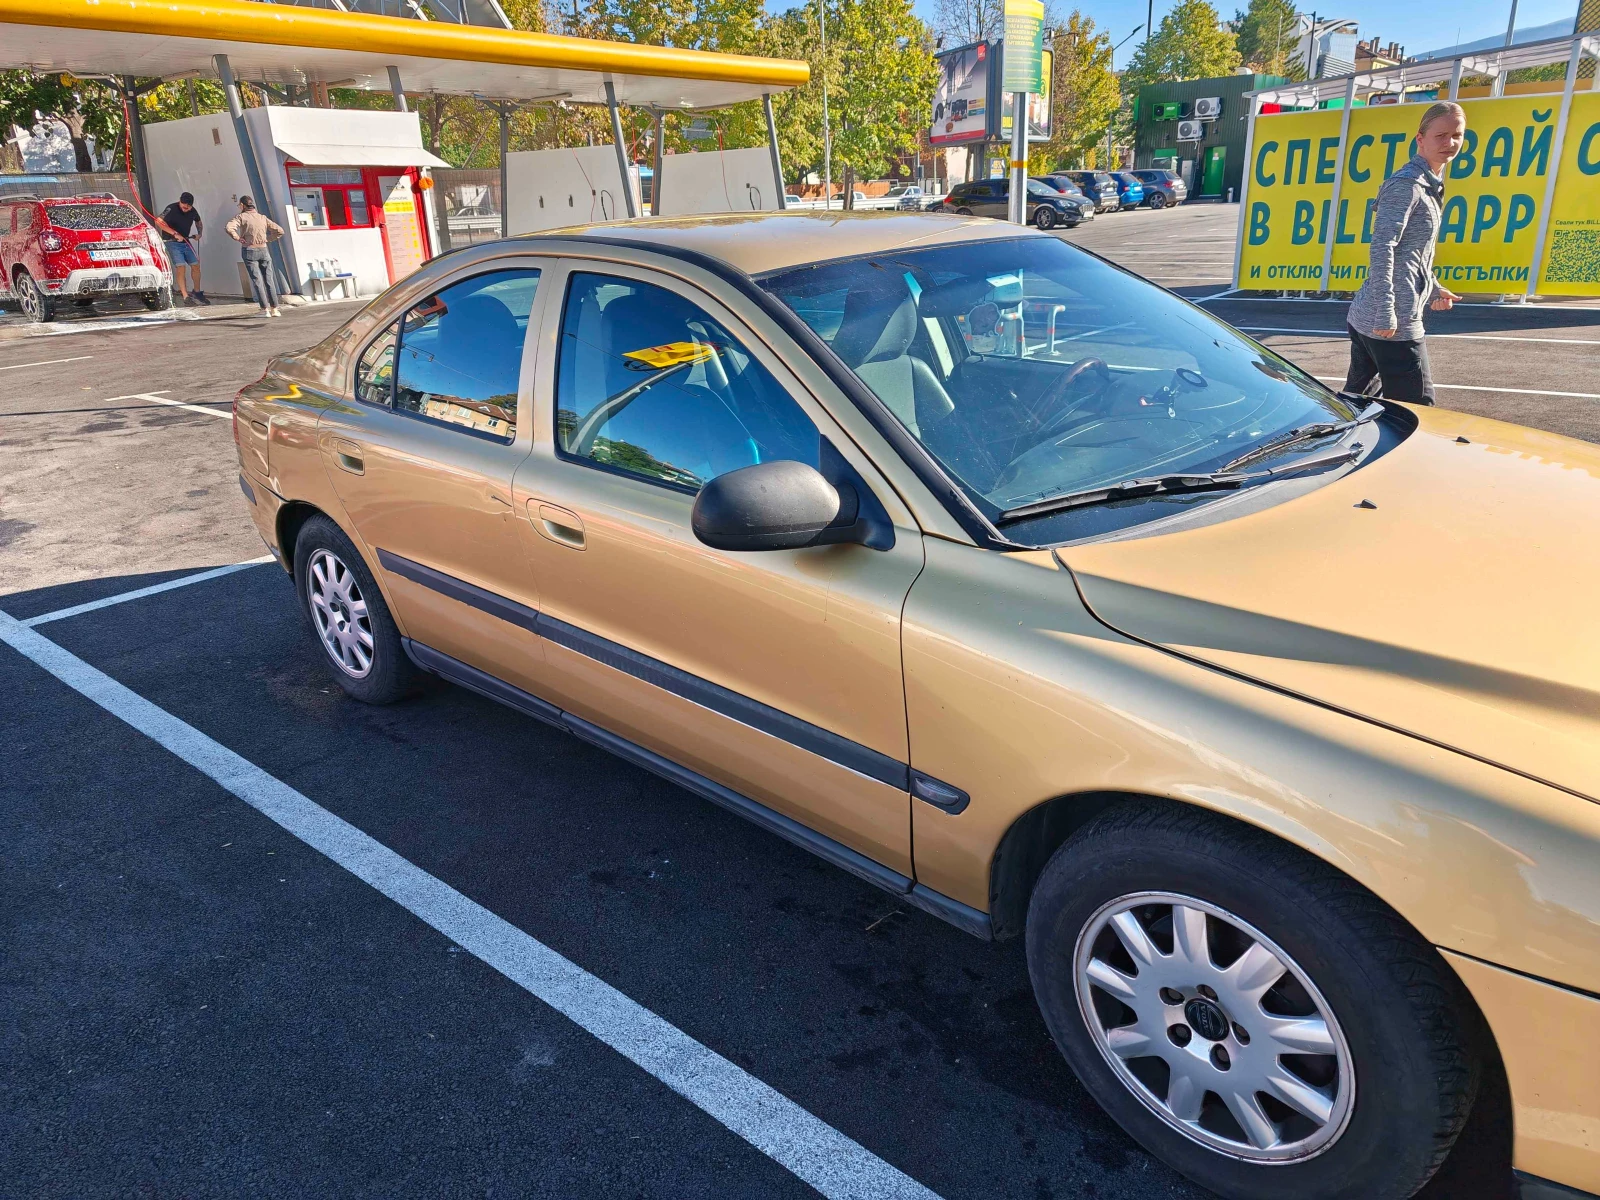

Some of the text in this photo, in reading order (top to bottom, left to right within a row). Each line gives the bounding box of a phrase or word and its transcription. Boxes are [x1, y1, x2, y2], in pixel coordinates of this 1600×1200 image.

[1255, 109, 1554, 188] СПЕСТВАЙ
[1248, 193, 1536, 246] В BILL APP
[1250, 265, 1261, 279] И
[1267, 265, 1352, 279] ОТКЛЮЧИ
[1432, 265, 1530, 281] ОТСТЪПКИ
